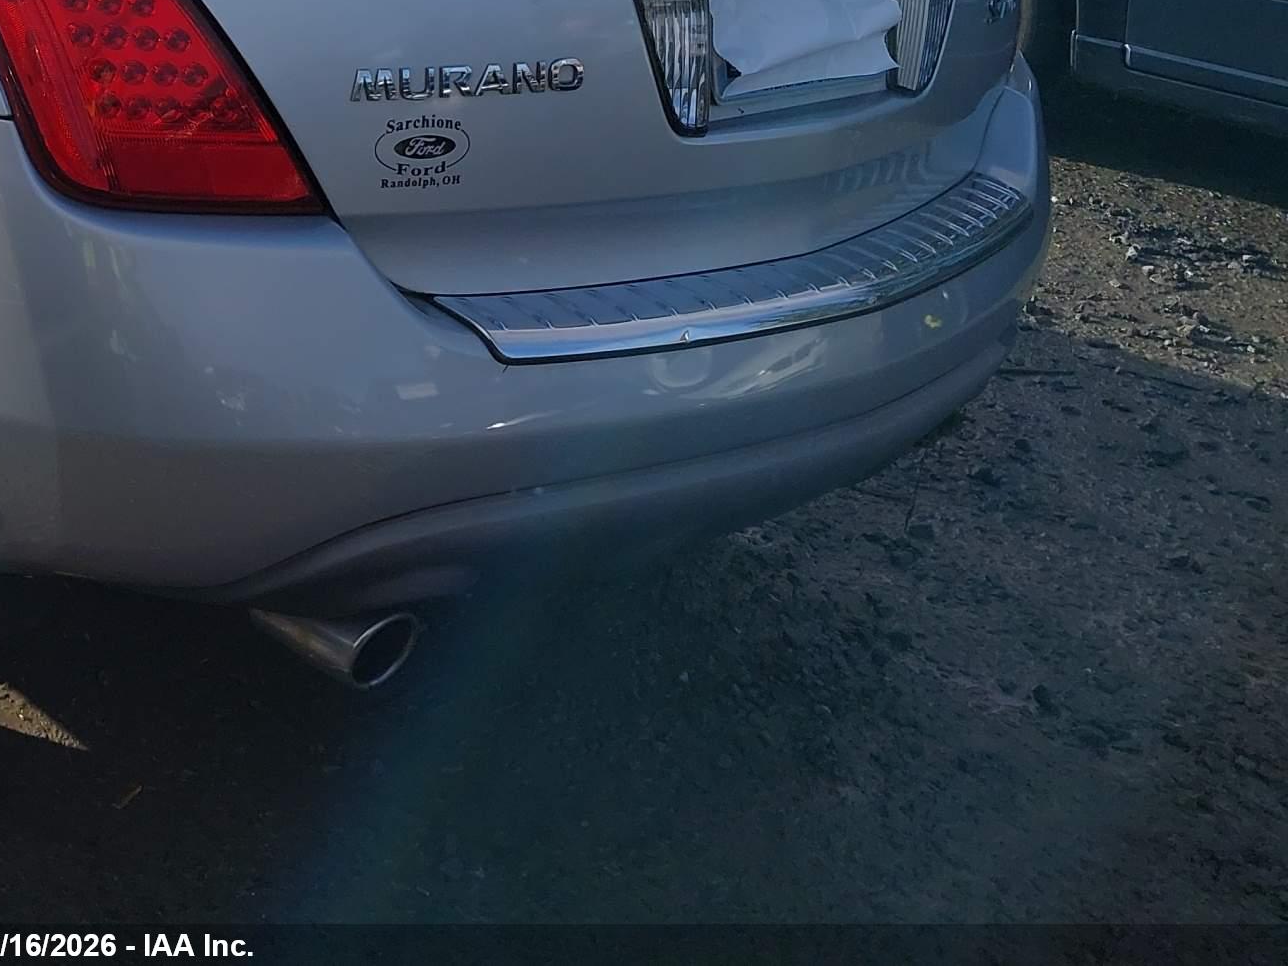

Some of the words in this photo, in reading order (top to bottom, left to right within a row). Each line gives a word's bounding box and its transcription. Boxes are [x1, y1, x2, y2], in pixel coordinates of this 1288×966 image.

[350, 56, 585, 102] MURANO
[385, 114, 462, 134] Sarchione
[405, 137, 447, 156] Ford
[396, 161, 447, 177] Ford
[380, 176, 440, 189] Randolph,
[442, 174, 461, 185] OH
